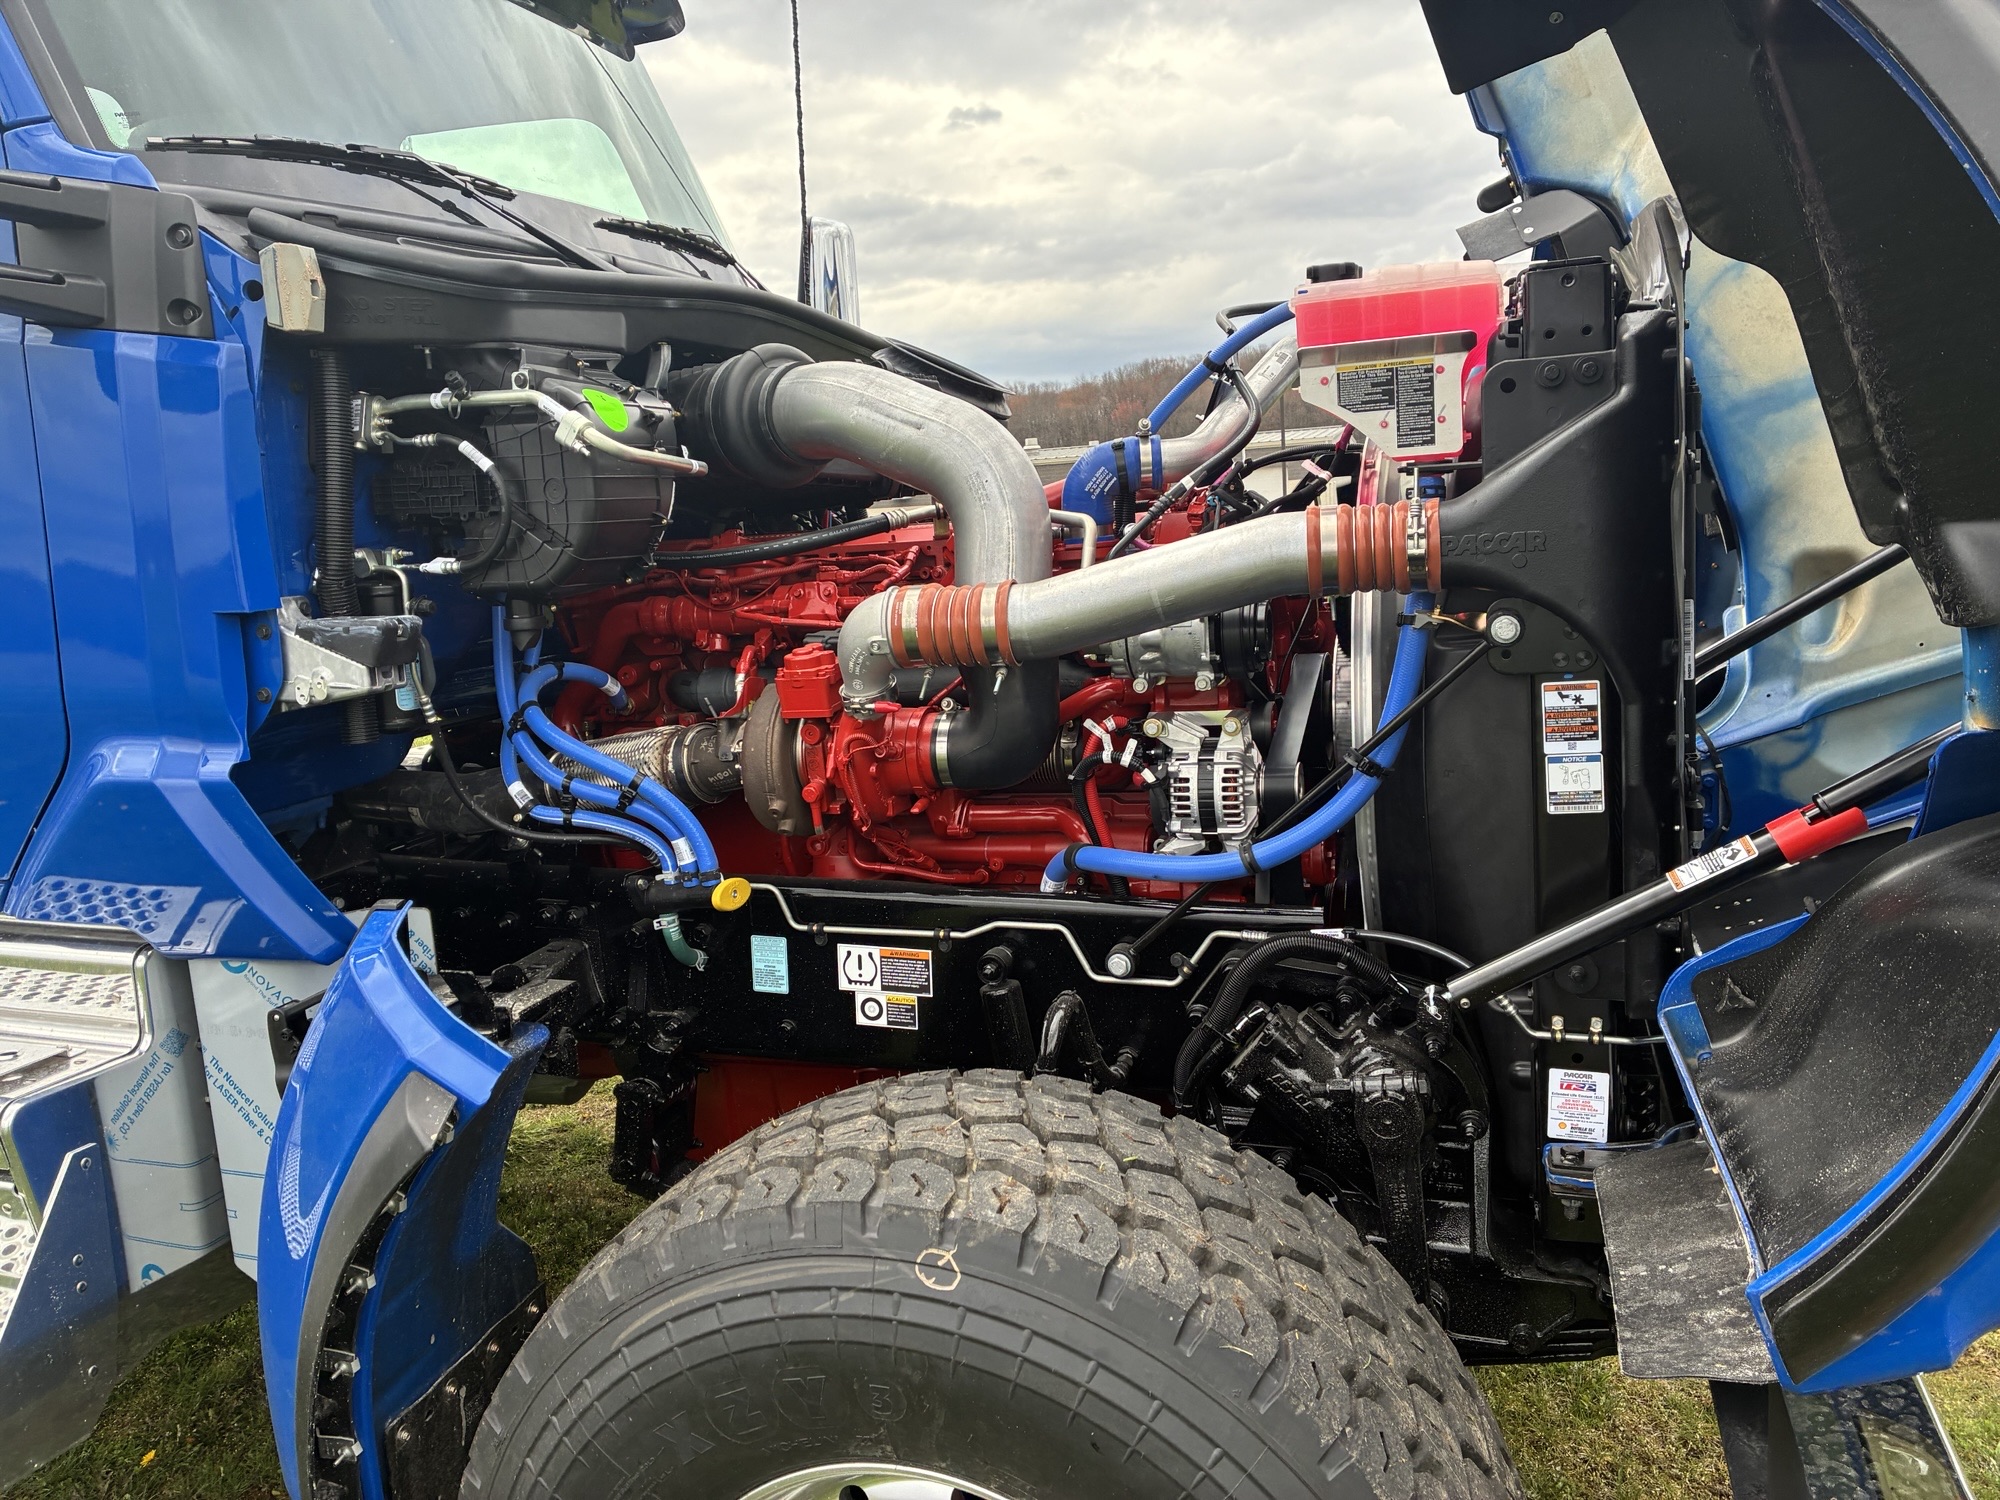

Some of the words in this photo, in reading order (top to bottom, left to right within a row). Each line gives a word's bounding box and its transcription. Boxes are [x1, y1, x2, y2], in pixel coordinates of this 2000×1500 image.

[1441, 530, 1547, 557] PACCAR
[414, 938, 435, 960] Fiber
[244, 974, 259, 990] Beyond
[258, 989, 267, 999] The
[209, 1055, 224, 1074] The
[223, 1072, 255, 1107] Novacel
[1564, 1072, 1593, 1080] PACCAR
[212, 1078, 239, 1108] LASER
[238, 1106, 258, 1129] Fiber
[257, 1128, 265, 1137] &
[264, 1136, 272, 1146] C
